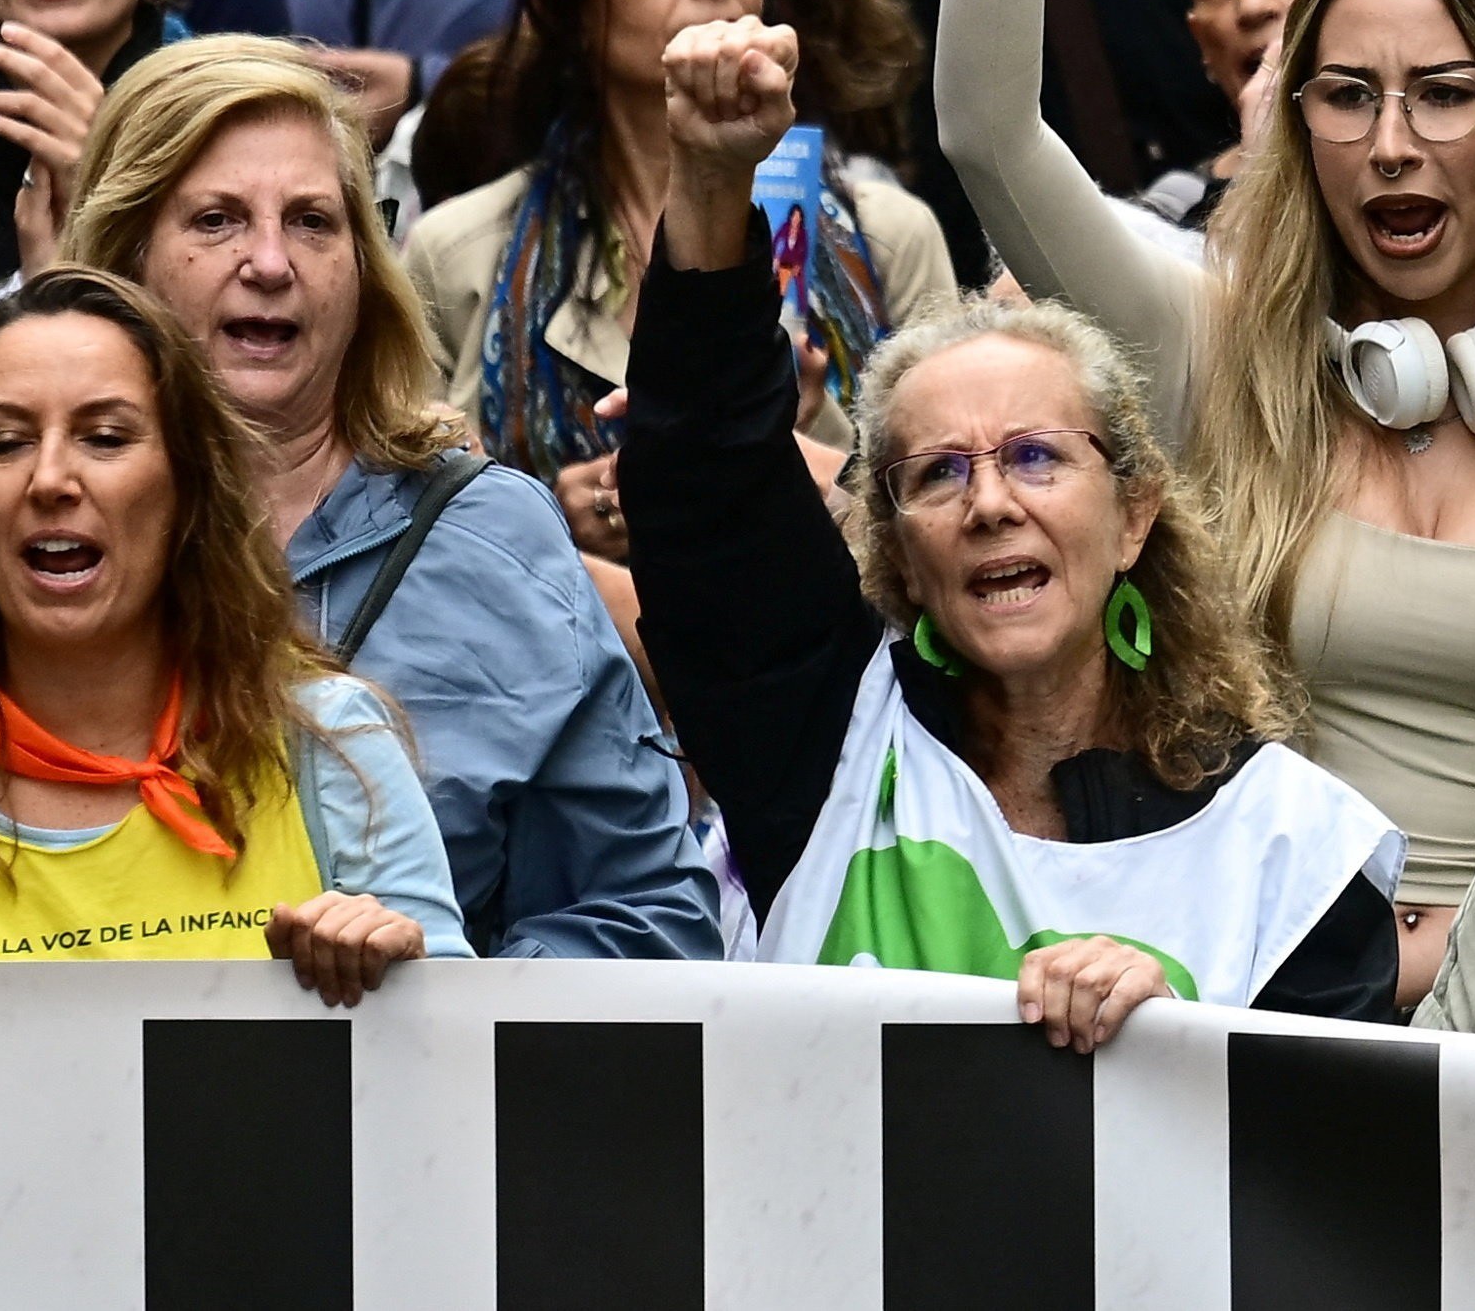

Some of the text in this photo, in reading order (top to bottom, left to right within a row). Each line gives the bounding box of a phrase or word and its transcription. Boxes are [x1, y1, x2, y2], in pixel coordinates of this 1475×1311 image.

[2, 937, 33, 954] LA
[41, 928, 93, 951] VOZ
[100, 923, 133, 943] DE
[141, 917, 172, 938] LA
[180, 908, 274, 933] INFANC
